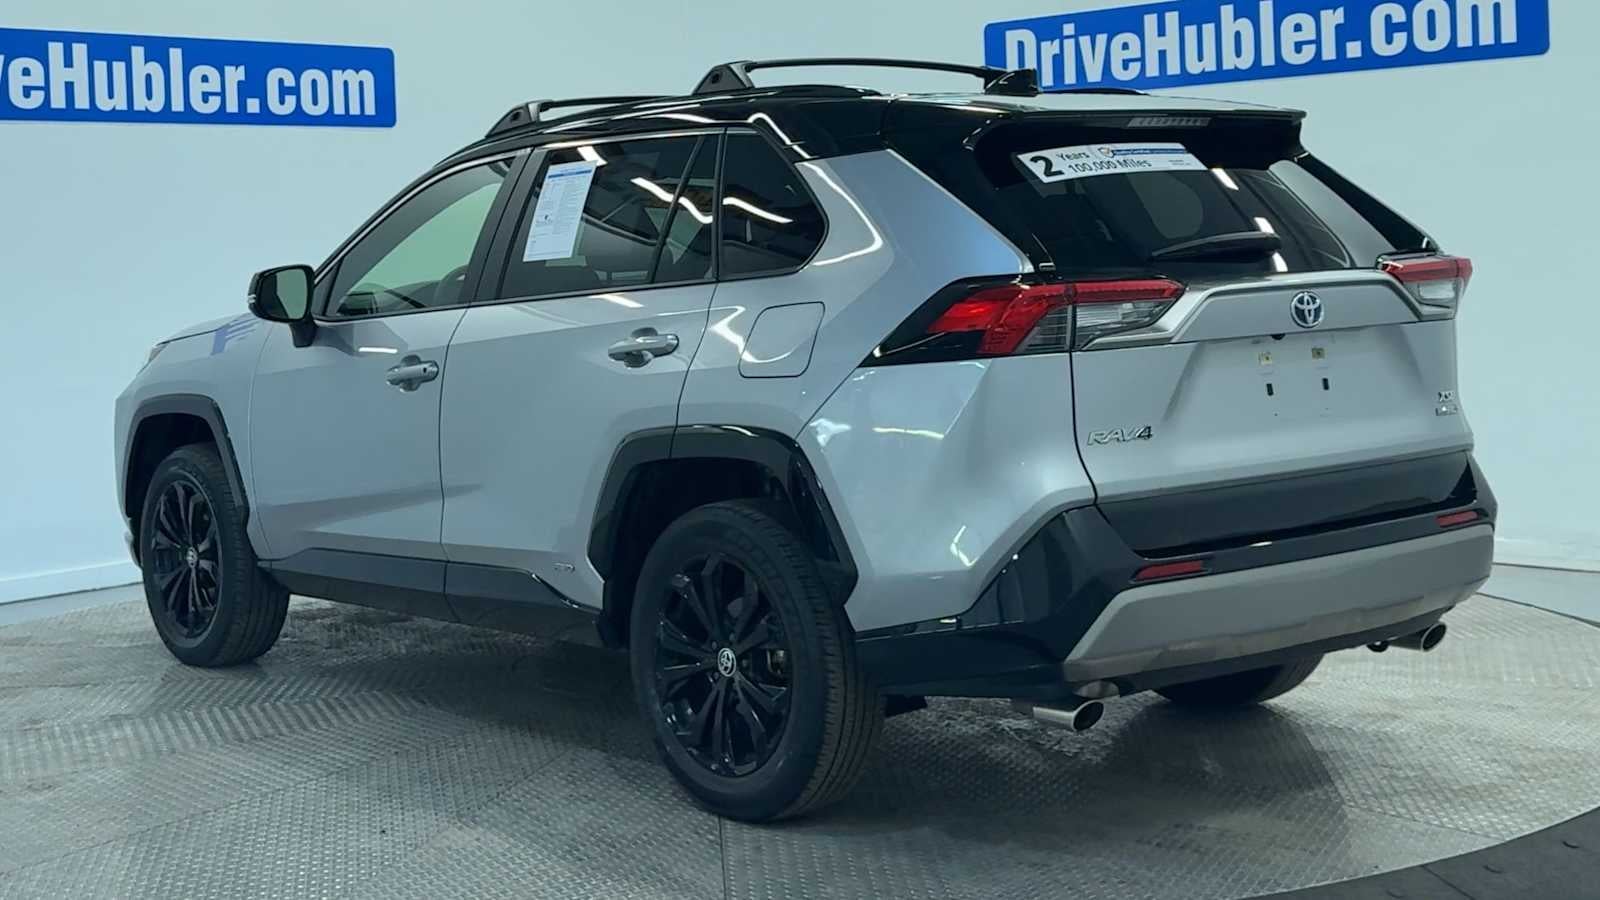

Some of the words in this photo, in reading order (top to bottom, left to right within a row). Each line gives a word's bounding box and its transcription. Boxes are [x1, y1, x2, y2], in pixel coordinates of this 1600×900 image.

[1005, 0, 1517, 87] DriveHubler.com
[0, 41, 376, 117] eHubler.com
[1029, 155, 1065, 177] 2
[1056, 152, 1090, 161] Years
[1068, 160, 1117, 173] 100,000
[1116, 158, 1153, 169] Miles
[1087, 425, 1153, 446] RAV4
